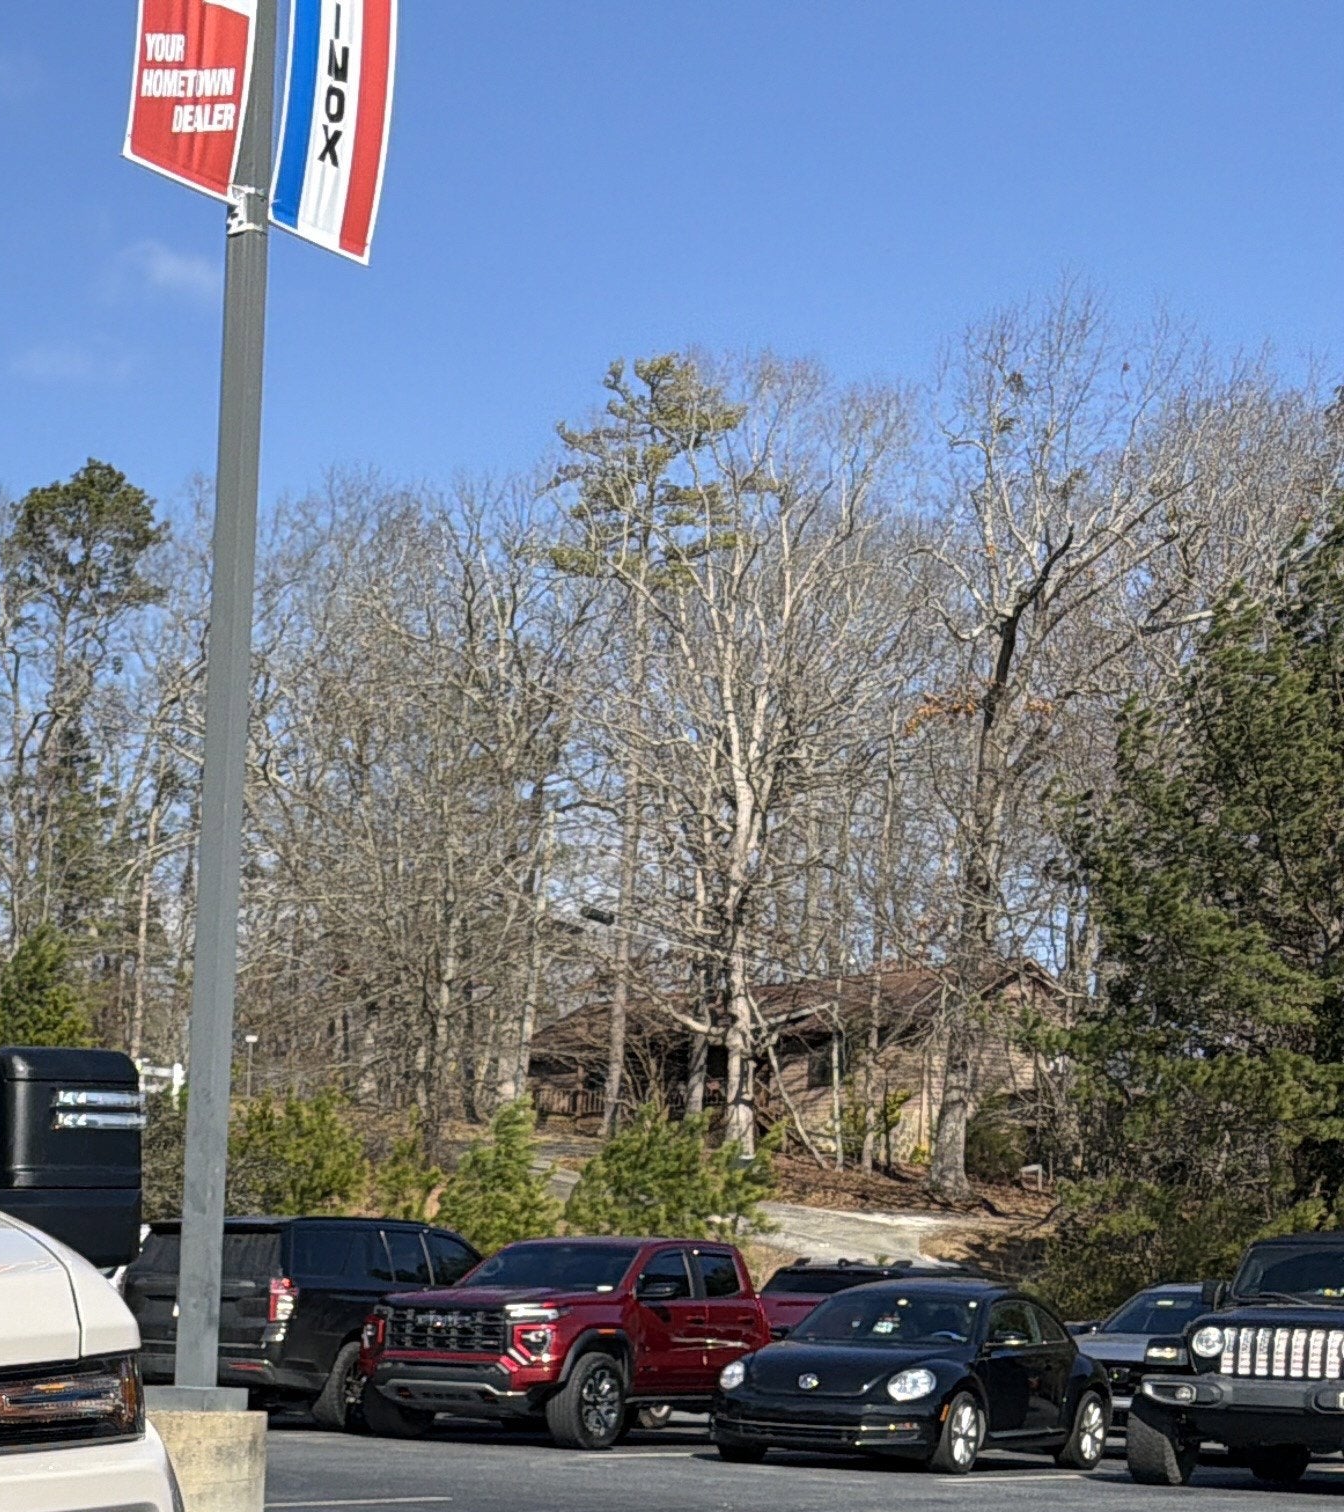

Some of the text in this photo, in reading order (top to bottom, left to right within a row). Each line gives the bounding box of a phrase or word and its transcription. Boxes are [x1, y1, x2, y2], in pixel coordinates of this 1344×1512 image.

[145, 32, 186, 62] YOUR
[141, 67, 236, 97] HOMETOWN
[171, 103, 236, 132] DEALER
